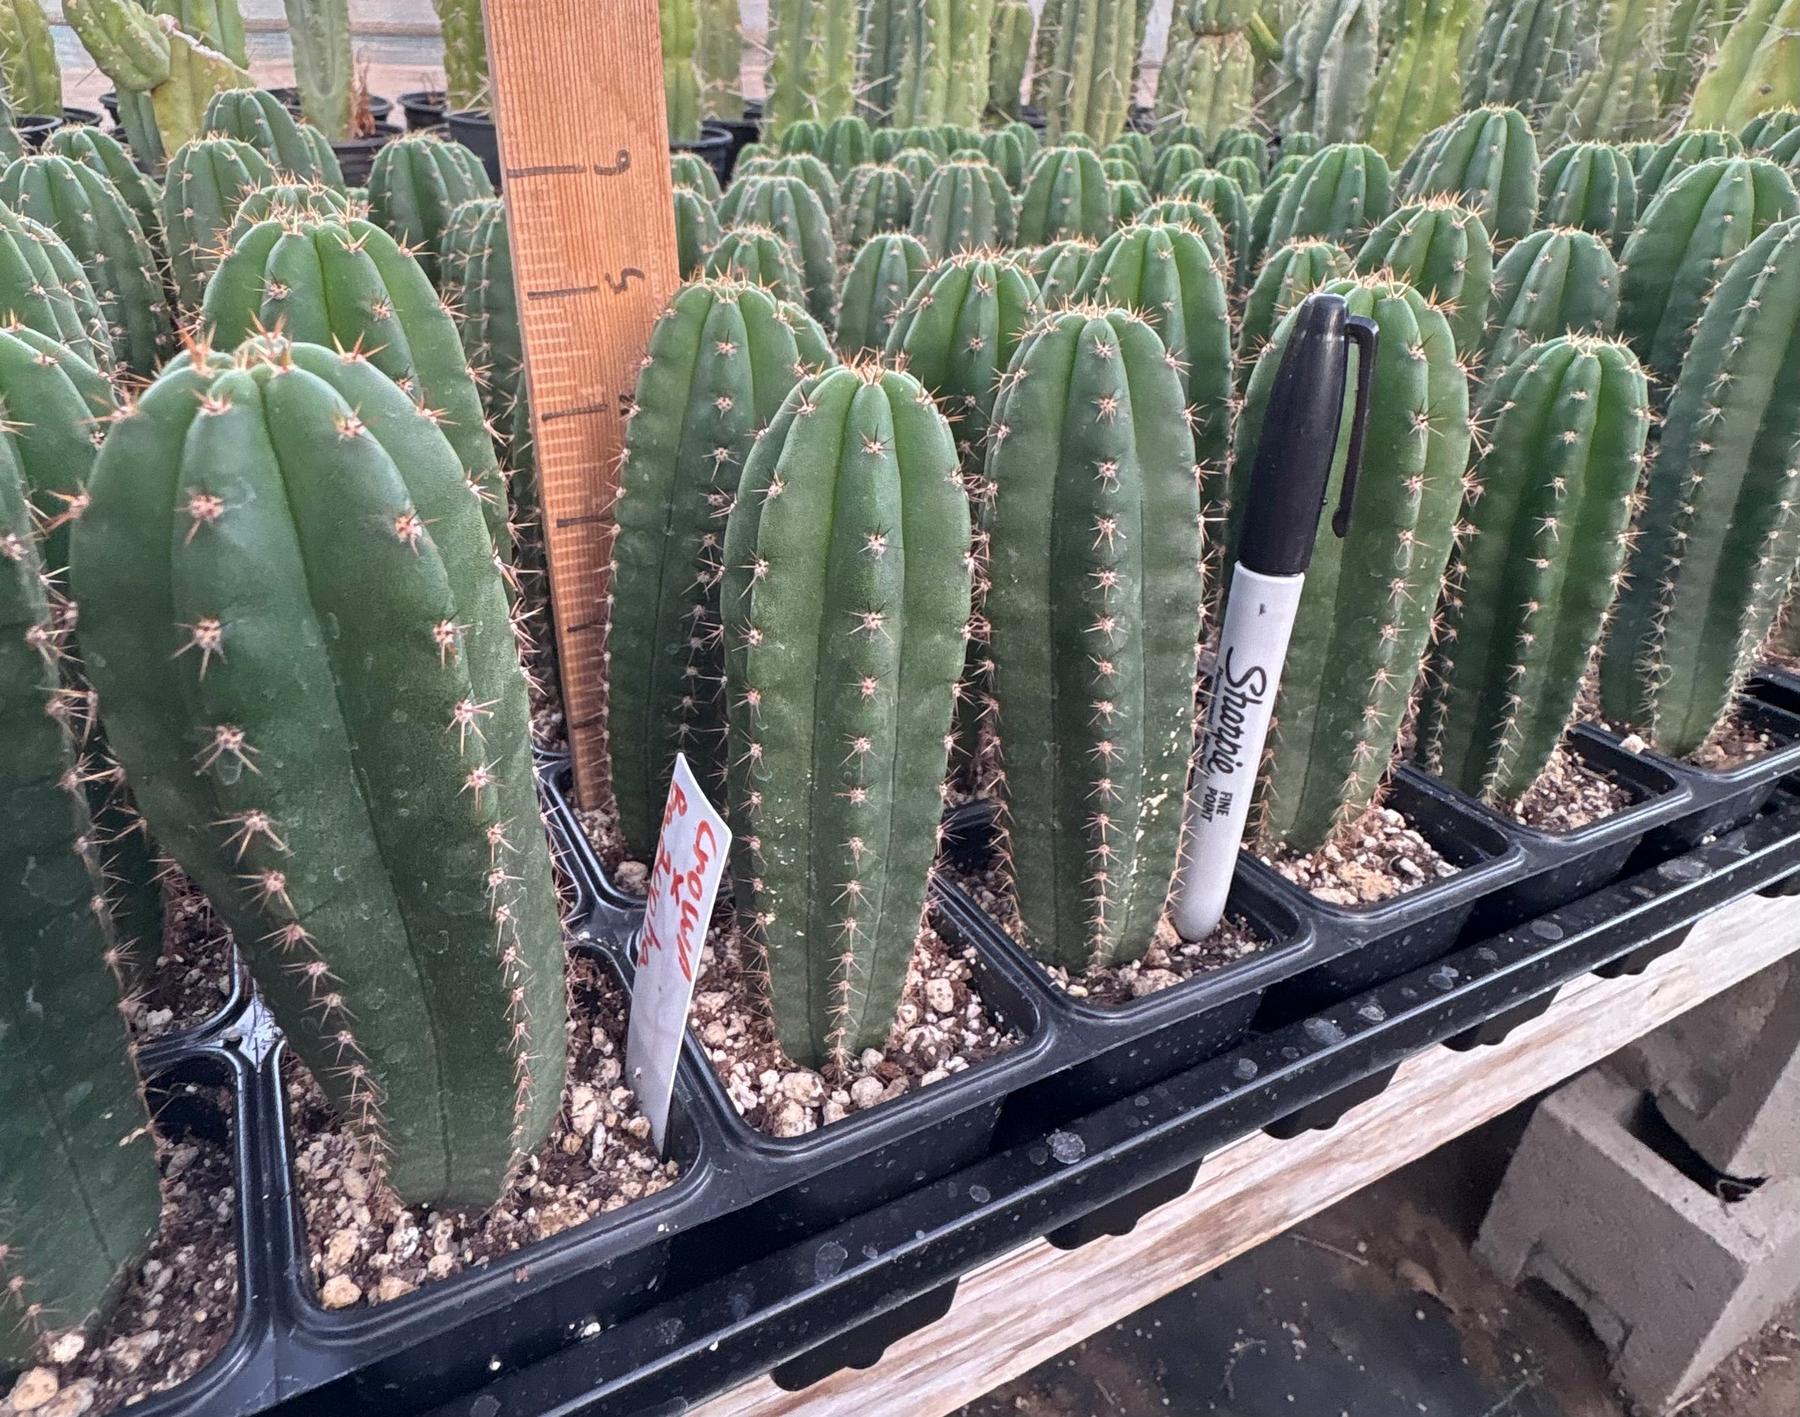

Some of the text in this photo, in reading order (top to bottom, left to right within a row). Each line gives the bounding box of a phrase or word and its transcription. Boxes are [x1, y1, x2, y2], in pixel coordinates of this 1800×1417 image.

[605, 266, 645, 295] 5
[1207, 646, 1267, 775] Sharpie
[1201, 785, 1218, 823] POINT
[1216, 790, 1233, 818] FINE
[676, 819, 717, 983] Crown
